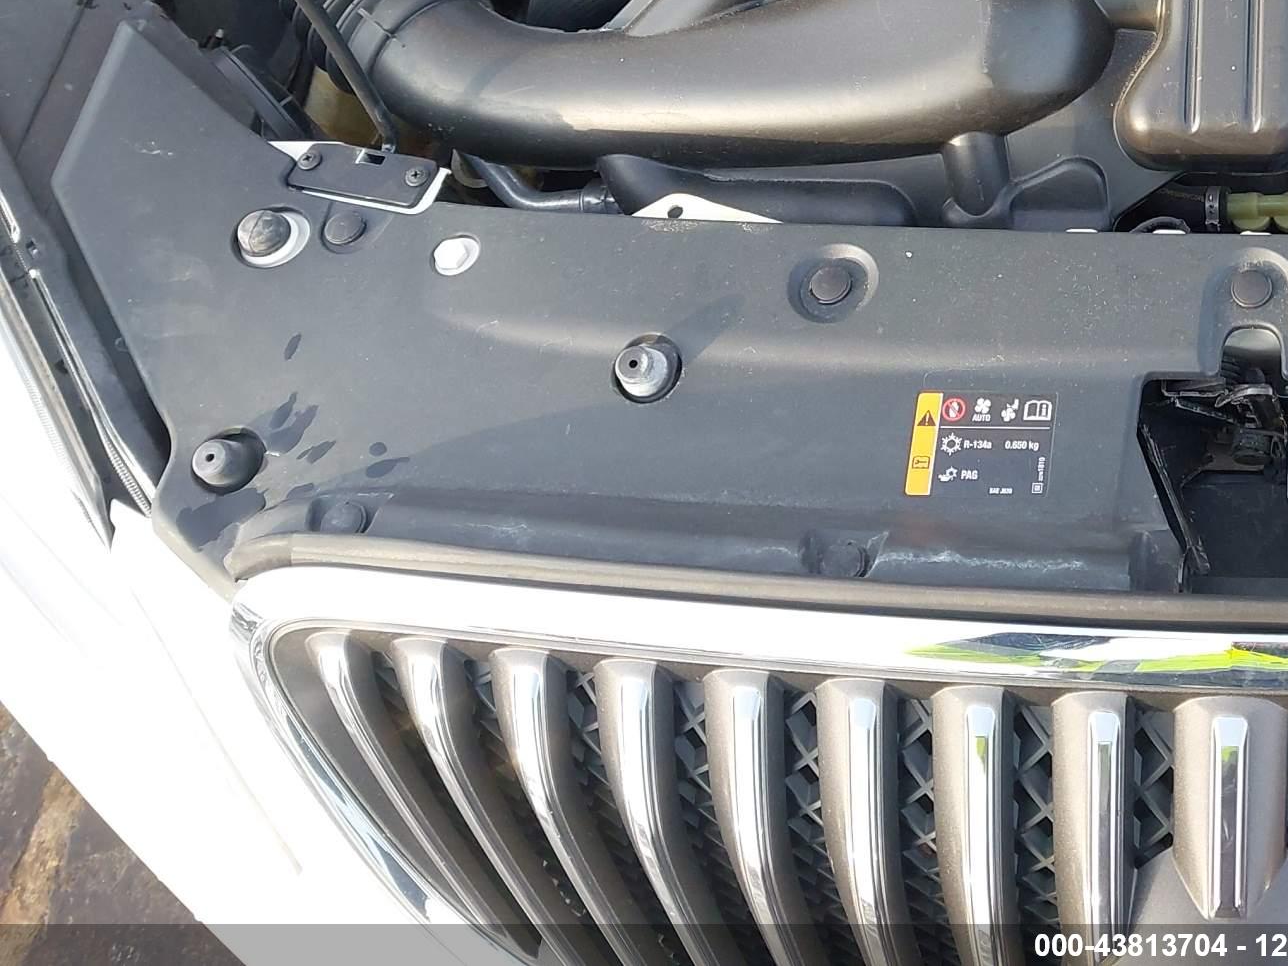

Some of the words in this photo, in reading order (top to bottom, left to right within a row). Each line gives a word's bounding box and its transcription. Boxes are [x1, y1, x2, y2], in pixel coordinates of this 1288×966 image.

[972, 413, 991, 422] AUTO
[963, 440, 992, 450] R-134a
[1004, 440, 1027, 451] 0.650
[1028, 440, 1040, 452] kg
[960, 470, 978, 481] PAG
